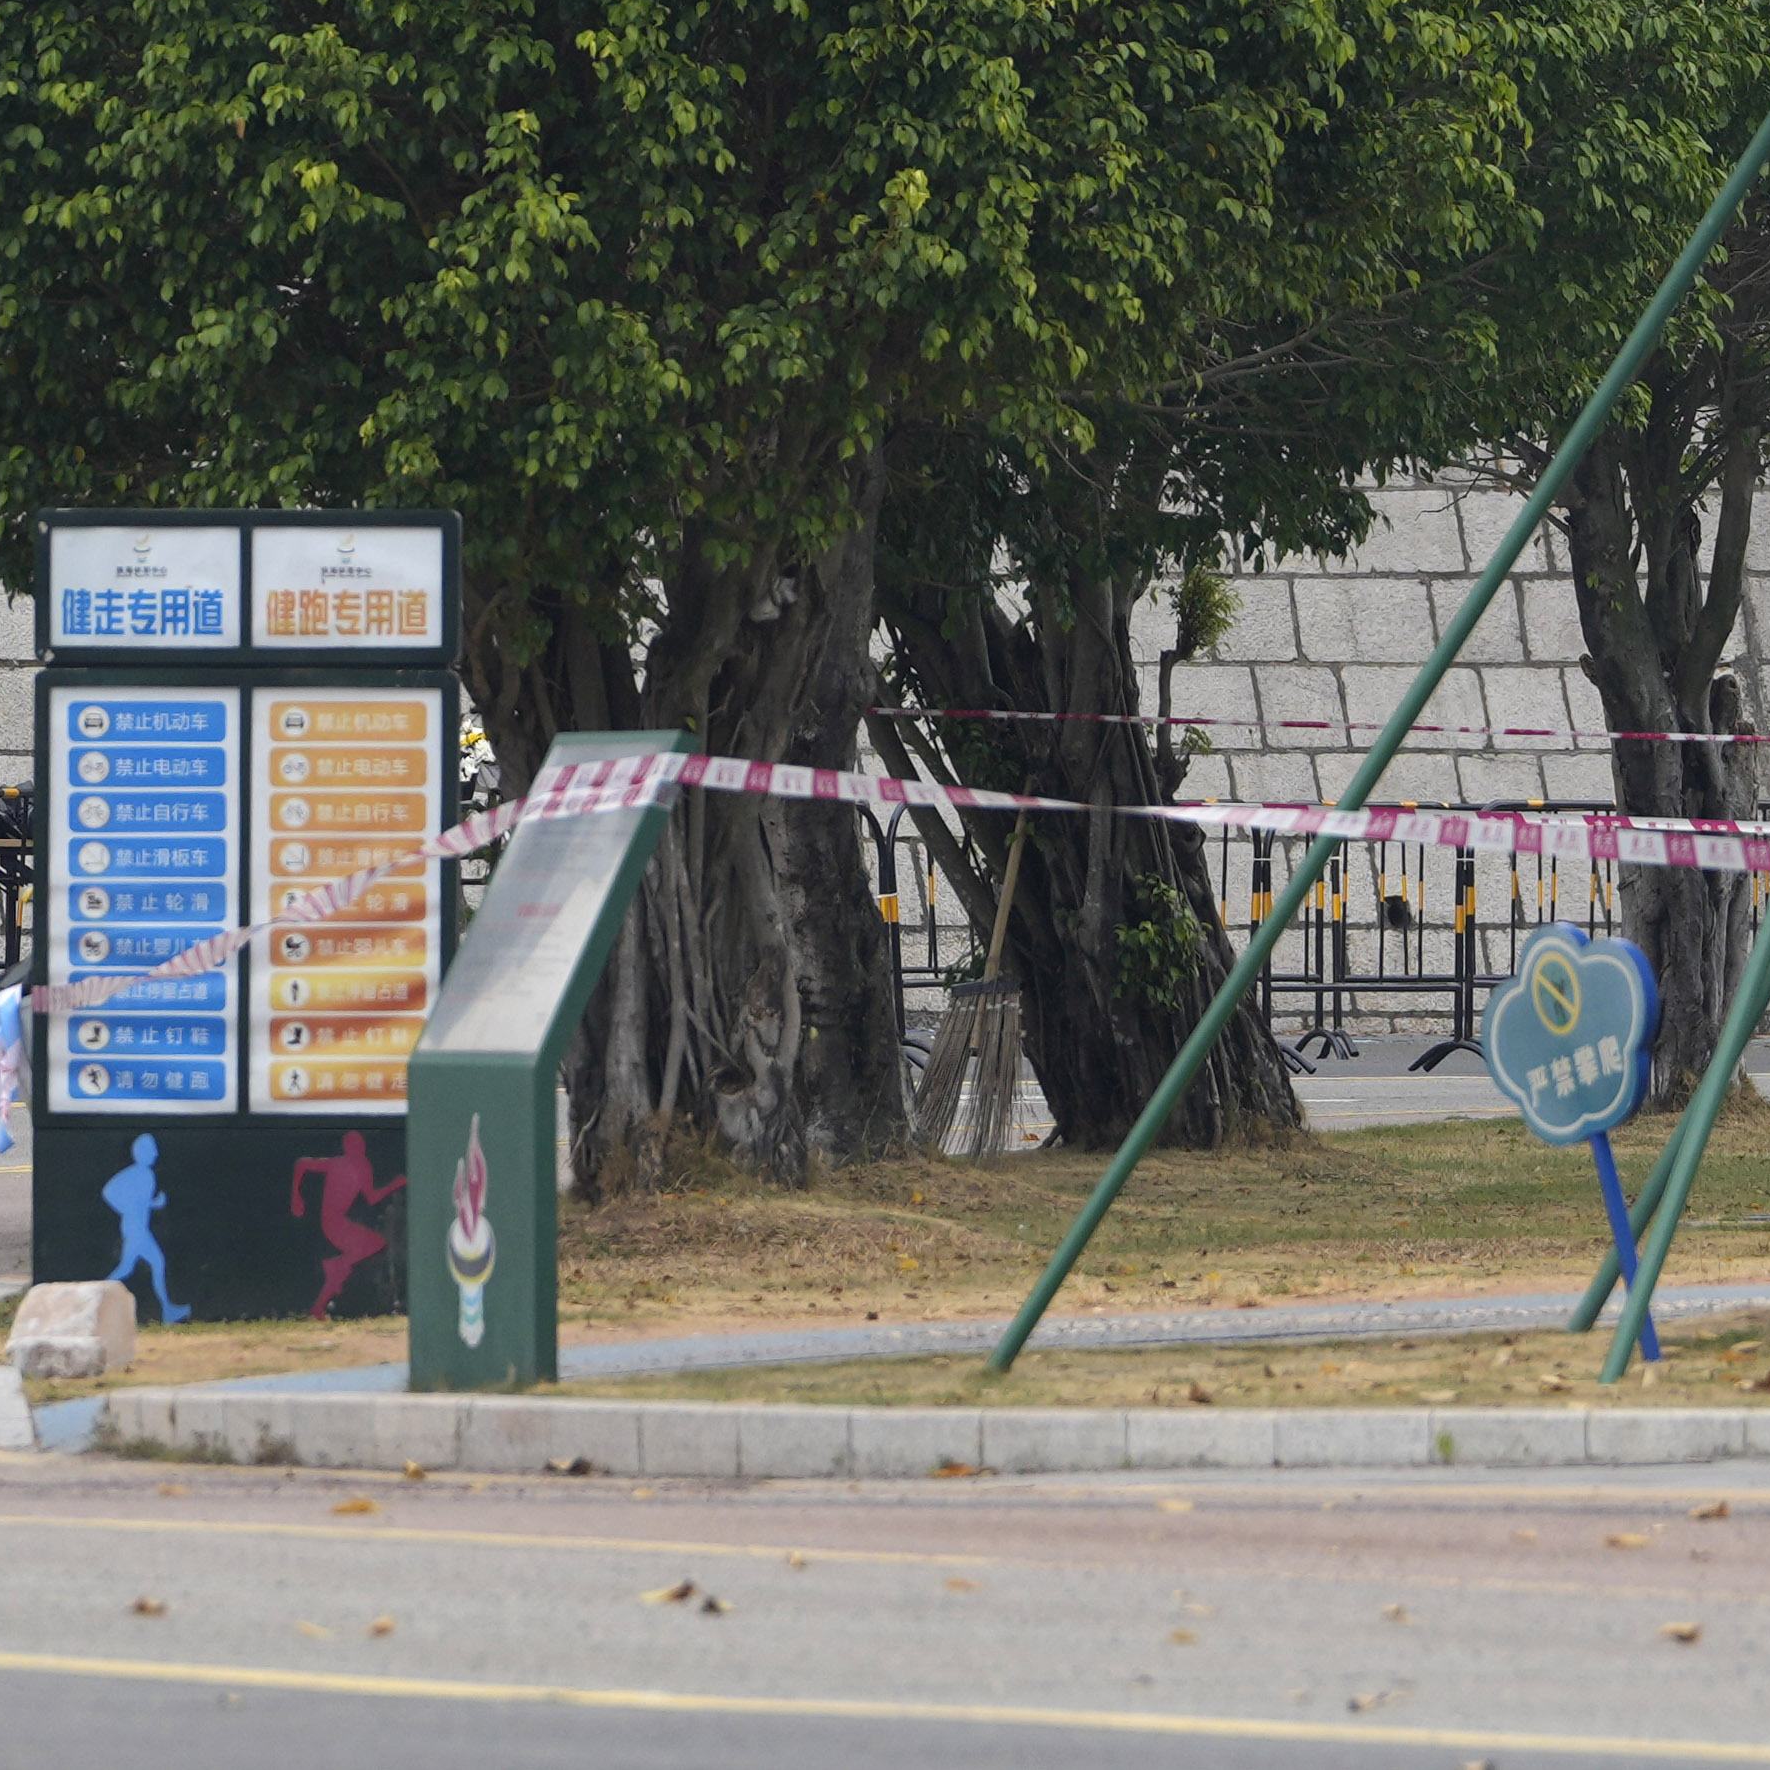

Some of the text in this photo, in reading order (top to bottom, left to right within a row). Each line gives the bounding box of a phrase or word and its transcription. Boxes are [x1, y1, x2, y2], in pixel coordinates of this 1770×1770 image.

[62, 587, 224, 636] 健走专用道
[266, 588, 428, 636] 健跑专用道
[115, 712, 209, 731] 禁止机动车
[115, 758, 209, 777] 禁止电动车
[316, 758, 409, 776] 禁止电动车
[115, 803, 209, 822] 禁止自行车
[115, 848, 209, 867] 禁止滑板车
[116, 893, 209, 911] 禁止轮滑
[116, 937, 209, 956] 禁止婴儿
[115, 1026, 209, 1045] 禁止钉鞋
[116, 1071, 210, 1090] 请勿健跑
